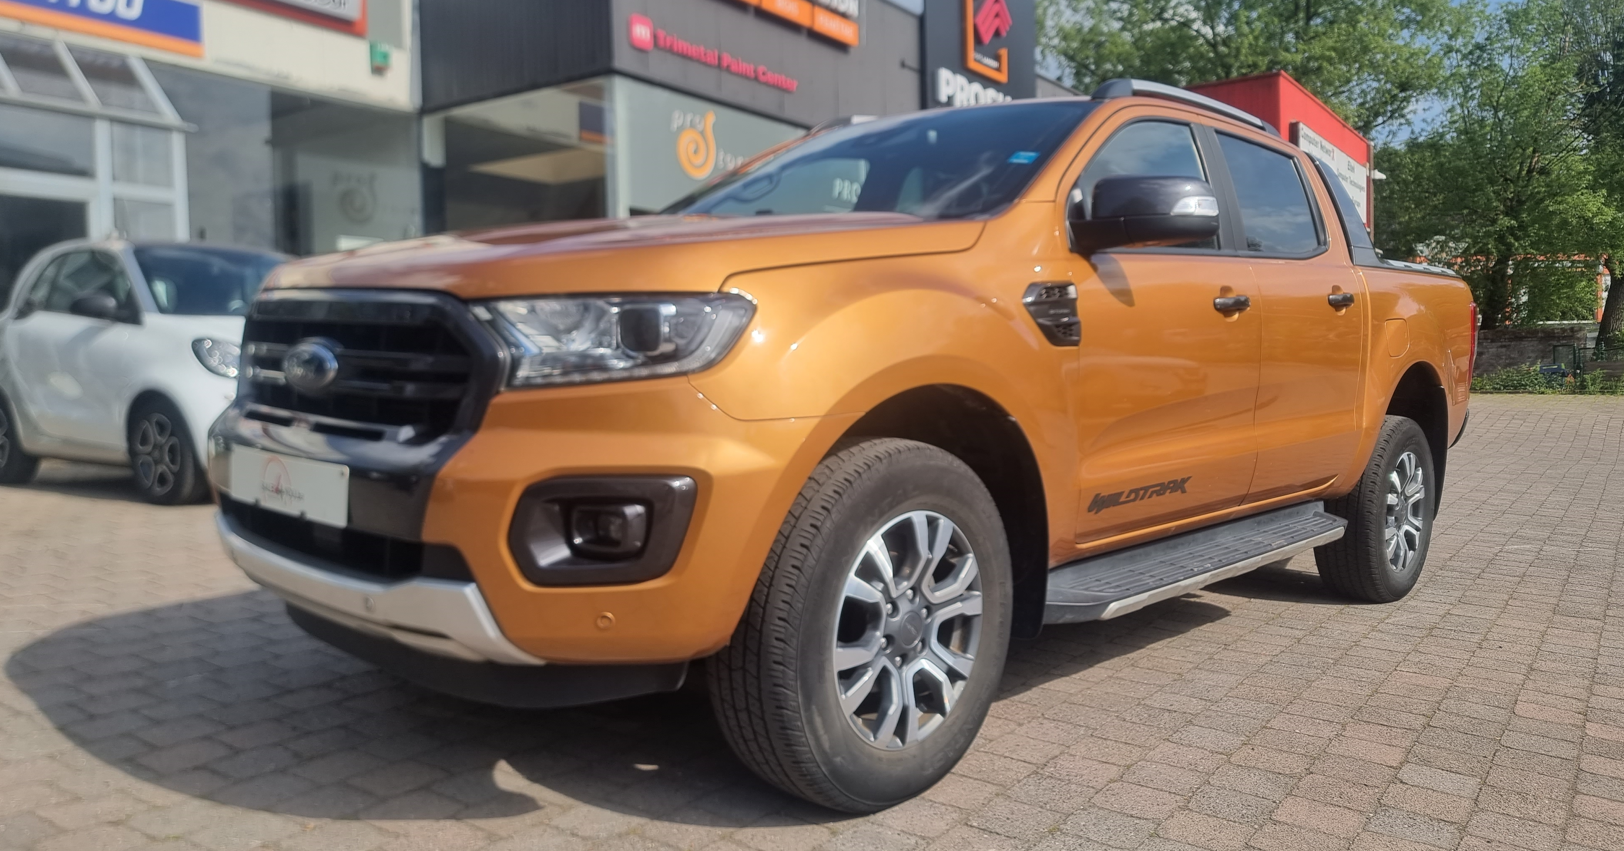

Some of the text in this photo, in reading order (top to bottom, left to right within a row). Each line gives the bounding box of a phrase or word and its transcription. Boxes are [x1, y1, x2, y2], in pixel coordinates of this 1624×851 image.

[655, 28, 719, 67] Trimetal
[720, 52, 755, 79] Paint
[756, 65, 798, 92] Center
[1087, 475, 1193, 515] WILDTRAK
